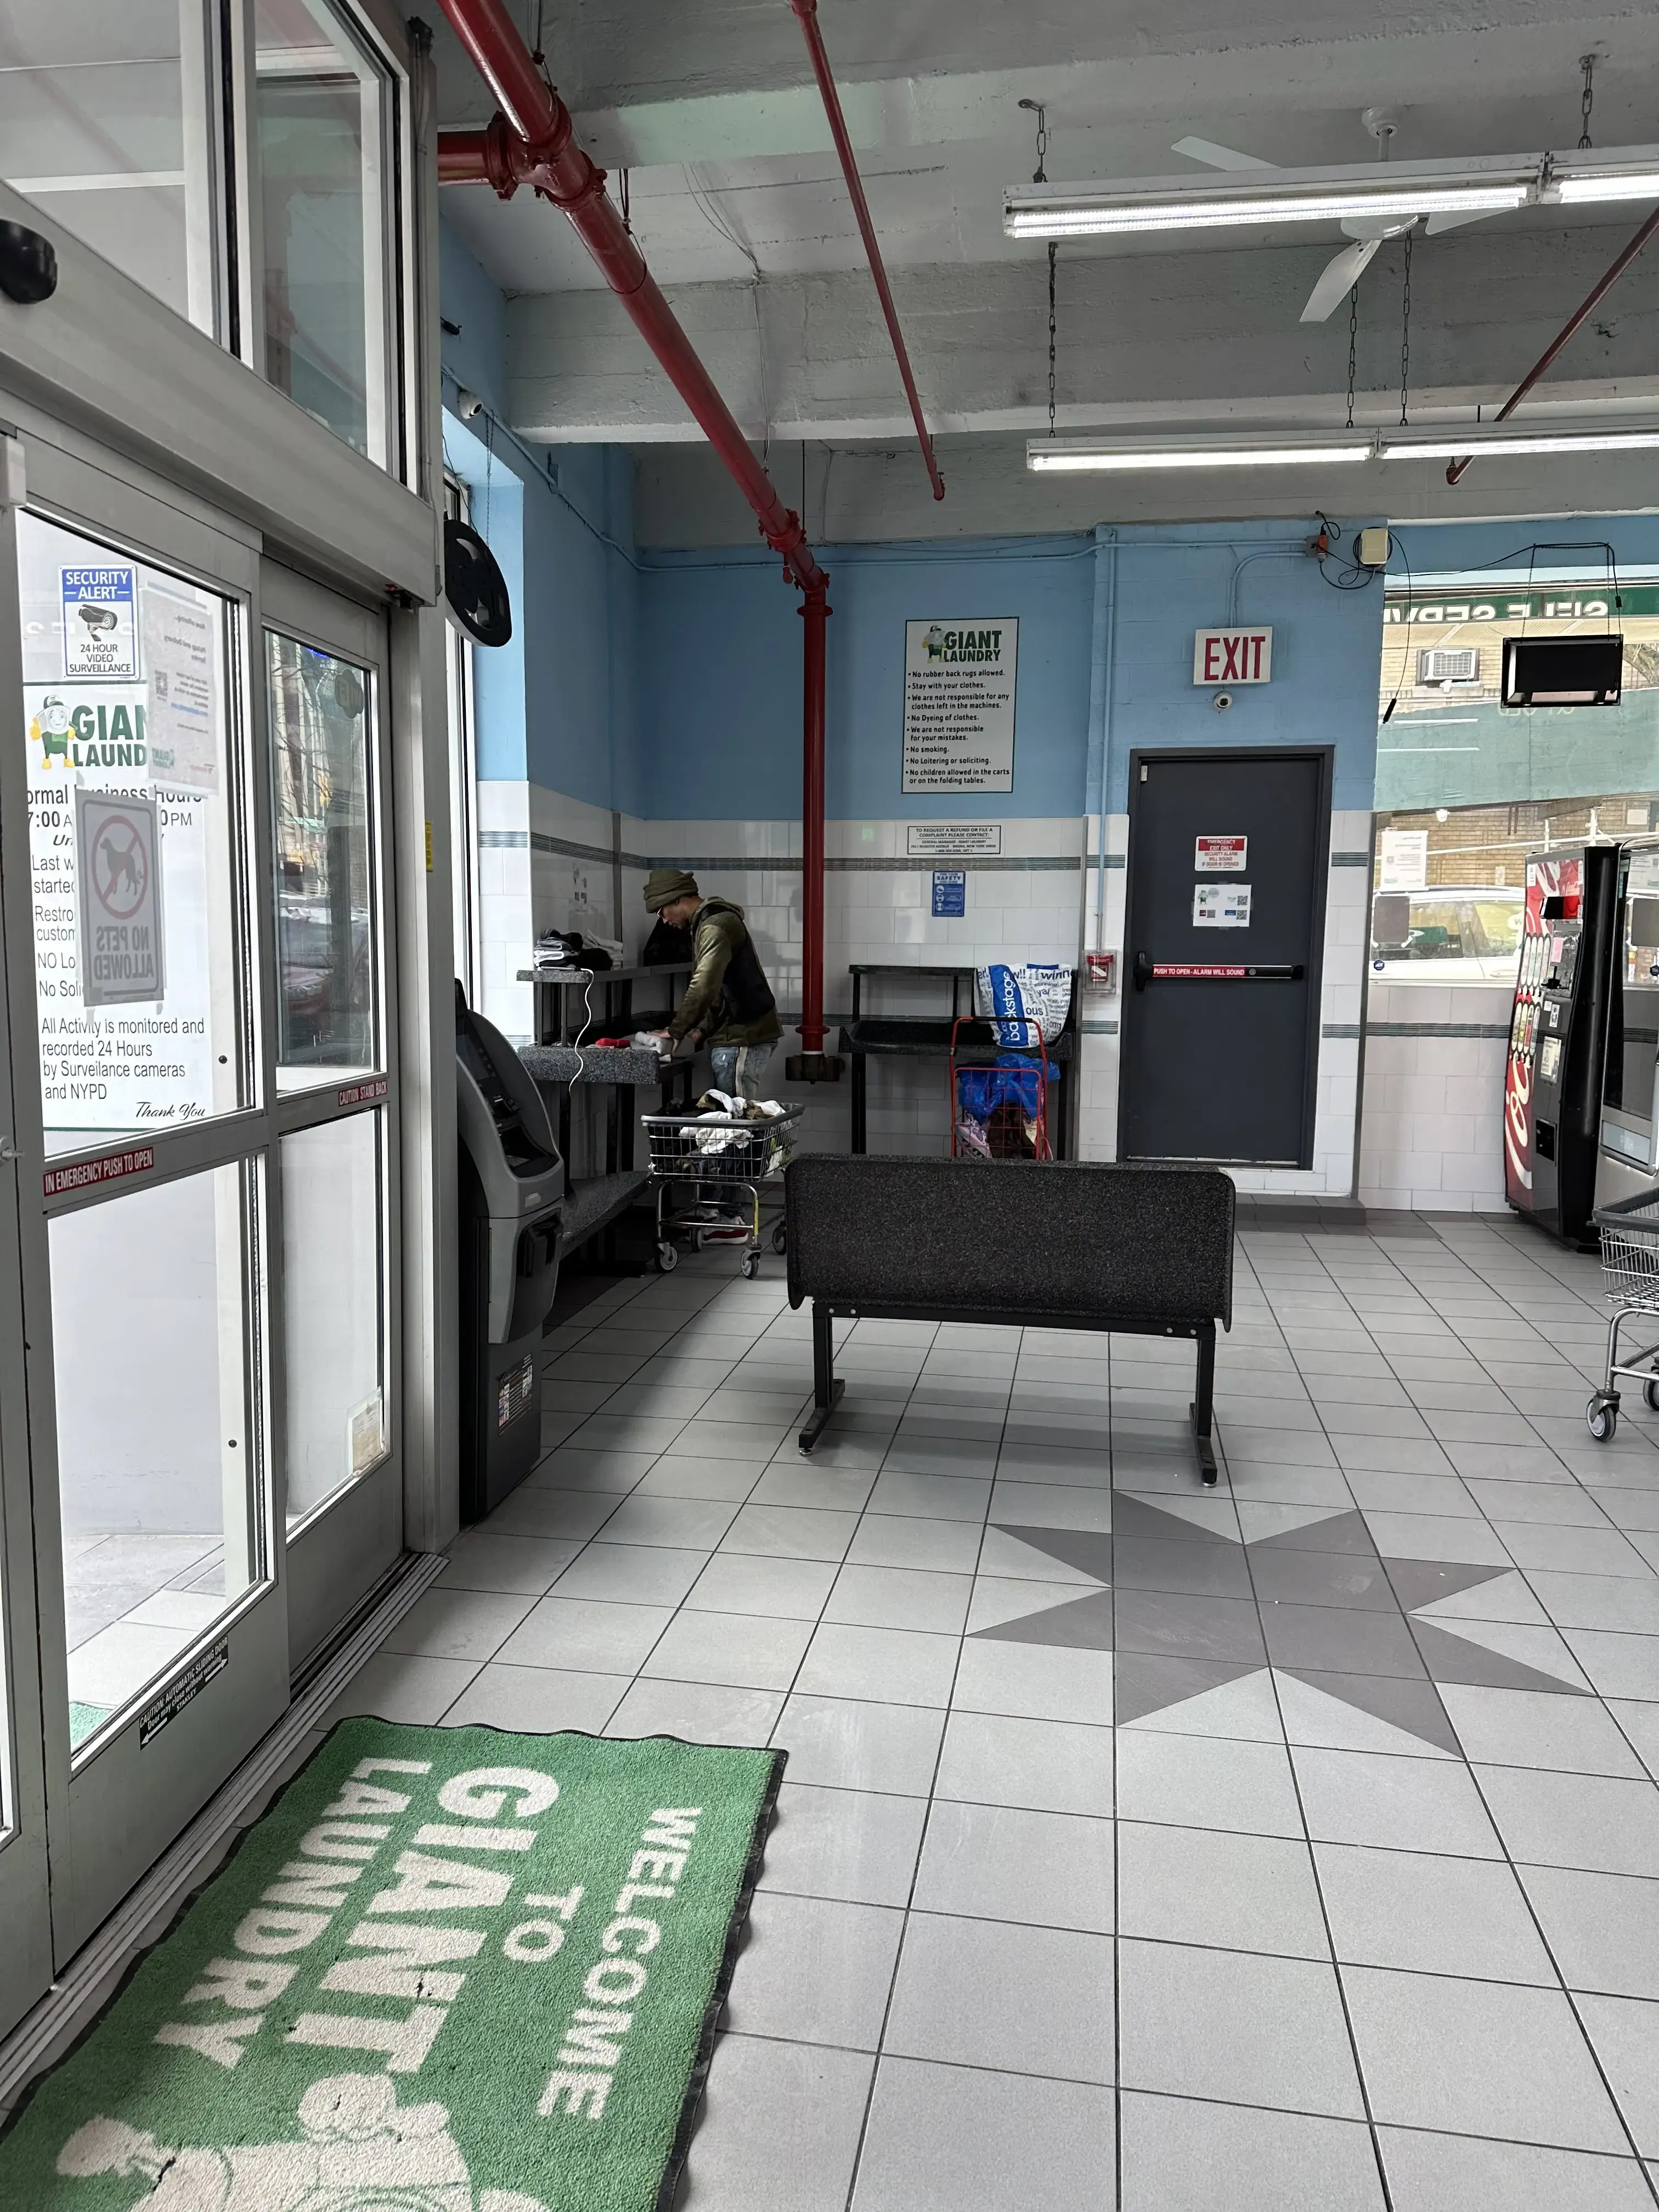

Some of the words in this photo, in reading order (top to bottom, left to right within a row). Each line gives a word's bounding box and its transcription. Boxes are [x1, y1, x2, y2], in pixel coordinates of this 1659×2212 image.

[66, 571, 128, 585] SECURITY
[78, 586, 117, 599] ALERT
[80, 644, 91, 652] 24
[93, 644, 118, 652] HOUR
[944, 630, 1002, 650] GIANT
[86, 654, 114, 662] VIDEO
[944, 650, 1001, 662] LAUNDRY
[1204, 636, 1266, 680] EXIT
[70, 663, 131, 673] SURVEILLANCE
[947, 693, 984, 702] responsible
[72, 704, 147, 741] GIA
[946, 725, 984, 733] responsible
[73, 743, 147, 767] LAUND
[27, 785, 68, 804] ormal
[171, 813, 191, 826] PM
[32, 854, 60, 871] Last
[35, 906, 74, 922] Restro
[38, 952, 57, 969] NO
[1041, 969, 1071, 980] winn
[40, 980, 55, 996] No
[42, 1018, 55, 1034] All
[105, 1018, 115, 1034] is
[119, 1018, 178, 1034] monitored
[182, 1018, 205, 1034] and
[42, 1040, 94, 1056] recorded
[98, 1040, 112, 1056] 24
[117, 1040, 153, 1057] Hours
[43, 1060, 57, 1080] by
[61, 1060, 130, 1077] Surveilance
[134, 1064, 185, 1077] cameras
[45, 1084, 66, 1099] and
[71, 1084, 107, 1099] NYPD
[339, 1087, 359, 1105] CAUTION
[360, 1084, 375, 1100] STAND
[375, 1081, 387, 1096] BACK
[136, 1102, 175, 1118] Thank
[179, 1102, 205, 1120] You
[45, 1173, 55, 1193] IN
[56, 1161, 102, 1190] EMERGENCY
[103, 1158, 123, 1178] PUSH
[123, 1154, 133, 1172] TO
[134, 1149, 153, 1170] OPEN
[166, 1668, 195, 1703] AUTOMATIC
[195, 1650, 215, 1674] SLIDING
[215, 1637, 228, 1656] DOOR
[148, 1715, 160, 1731] Door
[161, 1703, 171, 1718] may
[172, 1690, 185, 1707] close
[185, 1673, 203, 1694] without
[204, 1654, 222, 1676] warning
[155, 1757, 432, 2069] LAUNDRY
[283, 1765, 561, 2074] GIANT
[503, 1884, 584, 1962] TO
[537, 1807, 702, 2120] WELCOME
